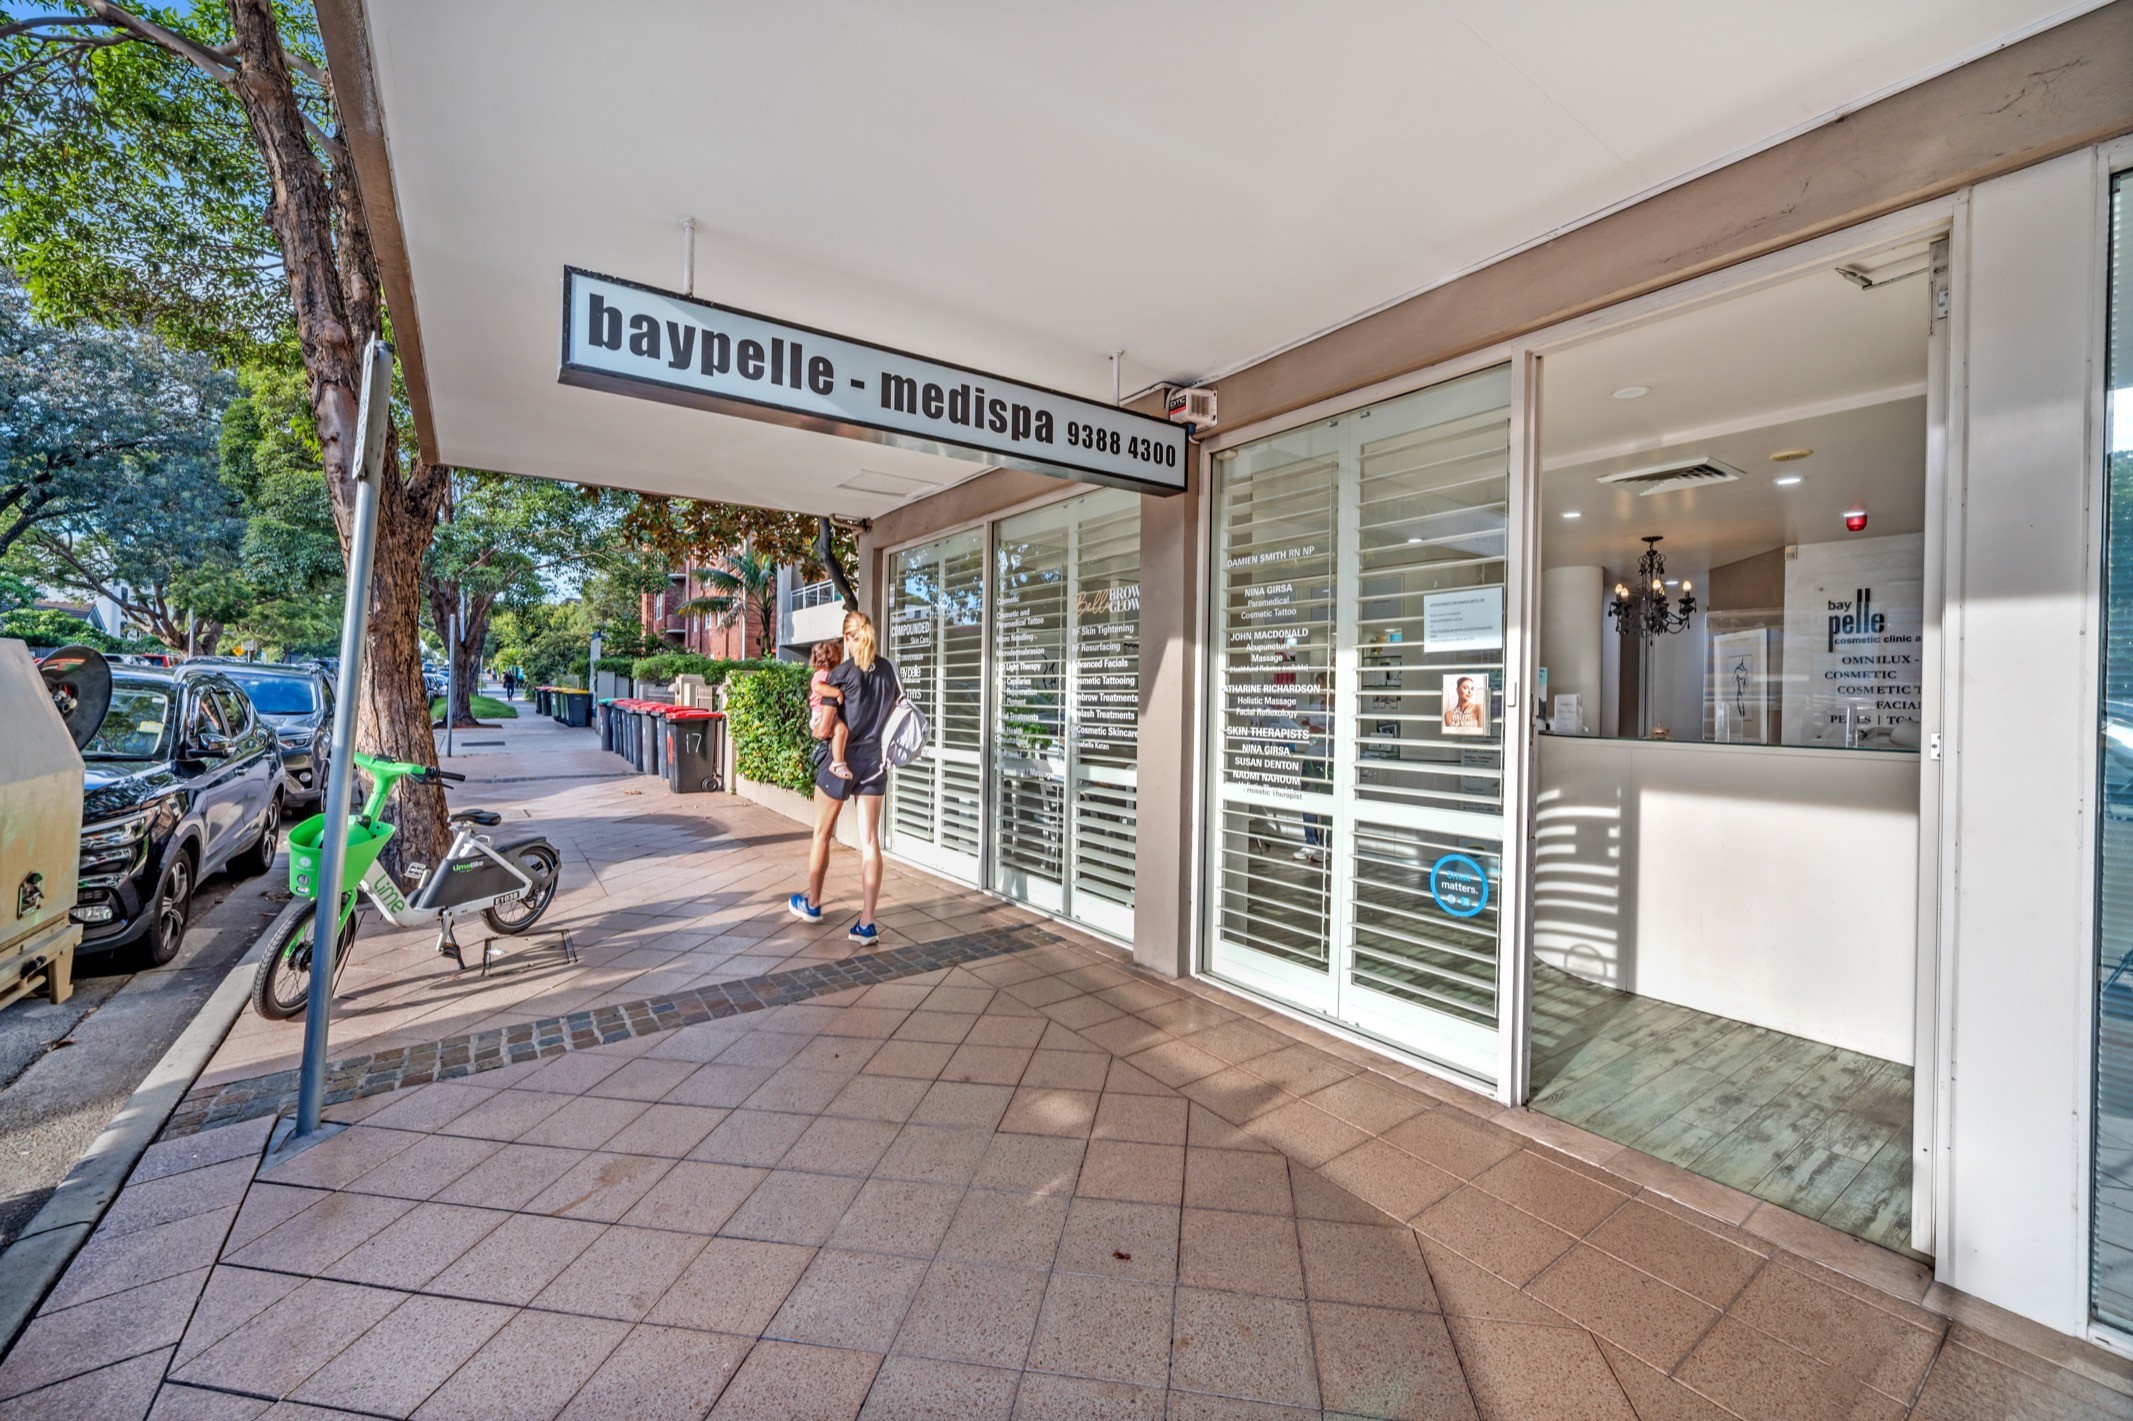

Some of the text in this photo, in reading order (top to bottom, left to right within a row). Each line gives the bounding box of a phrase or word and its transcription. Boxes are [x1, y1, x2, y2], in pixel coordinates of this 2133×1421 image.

[589, 293, 834, 395] baypelle
[881, 372, 1053, 444] medispa
[1068, 422, 1120, 455] 9388
[1128, 436, 1175, 467] 4300
[1227, 546, 1315, 568] DAMIEN SMITH RN NP
[1244, 584, 1292, 597] NINA GIRSA
[1248, 596, 1289, 607] Paramedical
[1828, 600, 1852, 612] bay
[997, 608, 1030, 619] Cosmetic and
[1241, 608, 1296, 619] Cosmetic Tattoo
[996, 617, 1044, 628] Paramedical Tattoo
[1828, 588, 1884, 652] pelle
[892, 621, 930, 637] COMPOUNDED
[1082, 626, 1096, 636] Skin
[1097, 624, 1134, 636] Tightening
[1011, 632, 1033, 642] Needling
[1230, 628, 1308, 641] JOHN MACDONALD
[1834, 636, 1880, 644] cosmetic
[1884, 635, 1912, 643] clinic
[1082, 642, 1120, 652] Resurfacing
[1246, 643, 1290, 652] Acupuncture
[1104, 659, 1128, 667] Facials
[1251, 654, 1283, 663] Massage
[1842, 655, 1910, 665] OMNILUX
[1006, 663, 1019, 672] Light
[1020, 662, 1041, 672] Therapy
[1825, 671, 1896, 679] COSMETIC
[1007, 677, 1031, 687] Capillaries
[1071, 676, 1135, 686] osmetic Tattooing
[1263, 685, 1320, 693] RICHARDSON
[1838, 686, 1910, 694] COSMETIC
[906, 689, 921, 700] THYS
[1071, 693, 1138, 703] ebrow Treatments
[1264, 697, 1296, 706] Massage
[1010, 713, 1039, 722] Treatments
[1096, 710, 1135, 720] Treatments
[1236, 708, 1298, 718] Facial Reflexology
[1830, 715, 1871, 724] PELS
[1076, 726, 1107, 736] Cosmetic
[1227, 726, 1309, 739] SKIN THERAPISTS
[686, 733, 701, 754] 17
[1242, 744, 1290, 756] NINA GIRSA
[1235, 757, 1299, 771] SUSAN DENTON
[1233, 771, 1300, 785] NAOMI NAHOUM
[1441, 881, 1478, 894] matters.
[374, 874, 405, 913] Lime
